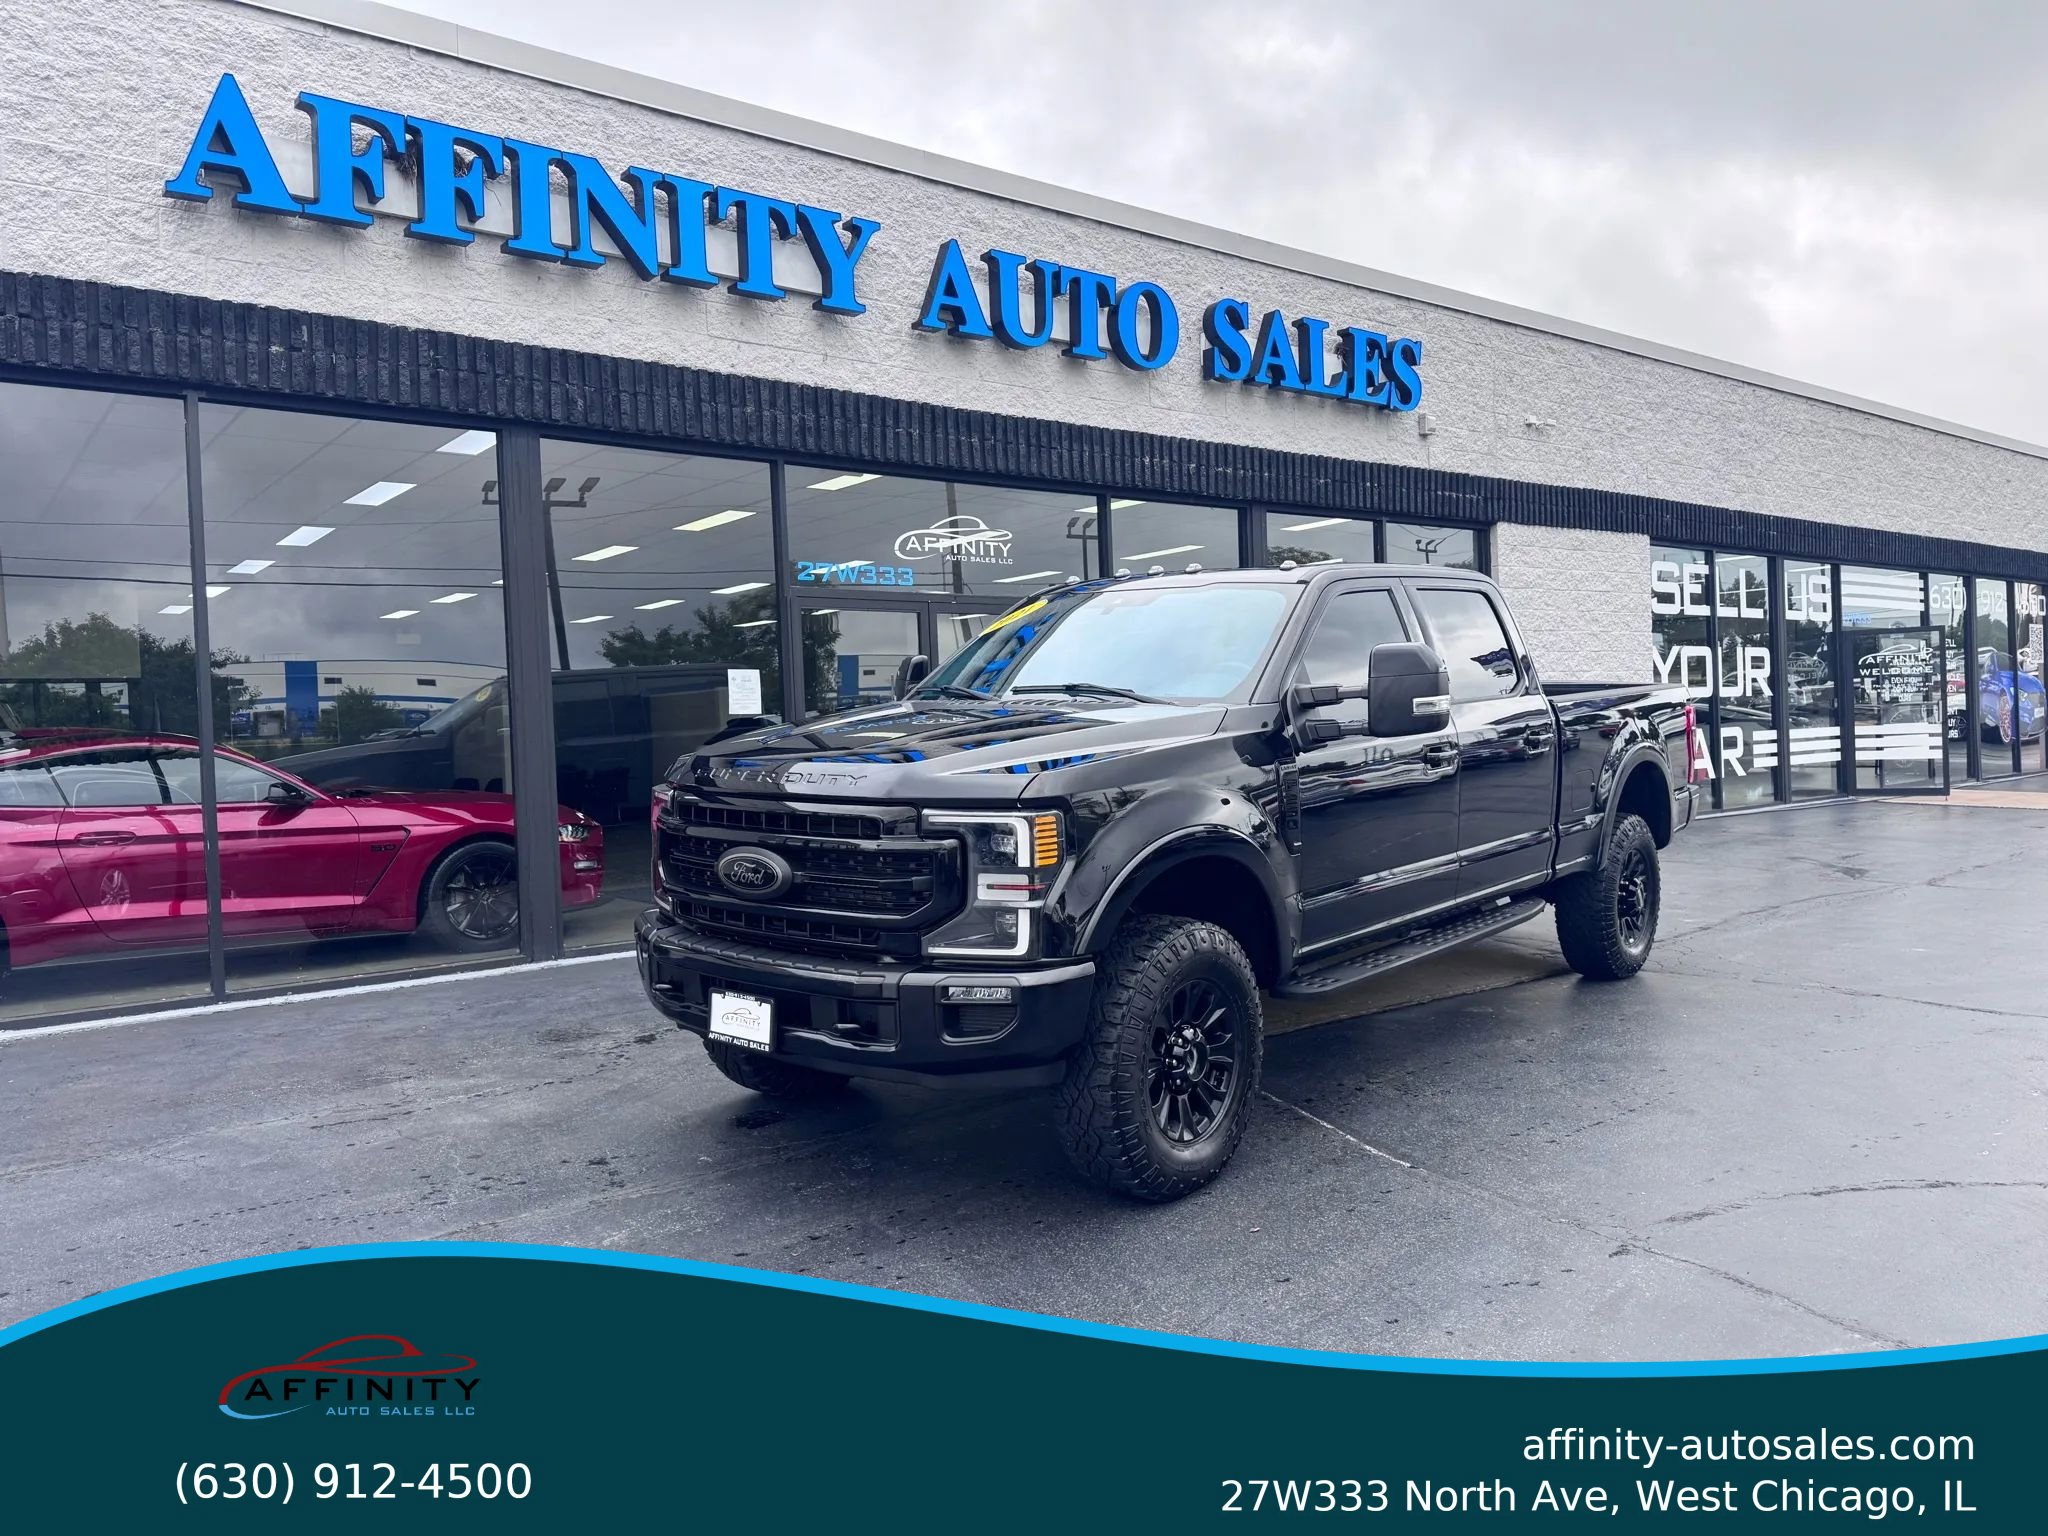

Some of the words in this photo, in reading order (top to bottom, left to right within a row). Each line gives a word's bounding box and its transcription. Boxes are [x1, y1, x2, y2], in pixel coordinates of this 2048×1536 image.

[165, 73, 881, 315] AFFINITY
[914, 239, 1180, 371] AUTO
[1204, 298, 1422, 411] SALES
[905, 535, 1012, 557] AFFINITY
[945, 554, 968, 562] AUTO
[970, 556, 996, 564] SALES
[797, 561, 914, 586] 27W333
[1651, 560, 1764, 619] SELL
[1785, 570, 1833, 622] US
[1652, 641, 1774, 698] YOUR
[1859, 665, 1934, 676] WELCOME
[1865, 653, 1933, 665] AFFINITY
[1693, 726, 1747, 779] AR
[781, 772, 868, 787] DUTY
[730, 860, 766, 885] Ford
[708, 1032, 732, 1043] AFFINITY
[733, 1038, 749, 1047] AUTO
[749, 1041, 770, 1052] SALES
